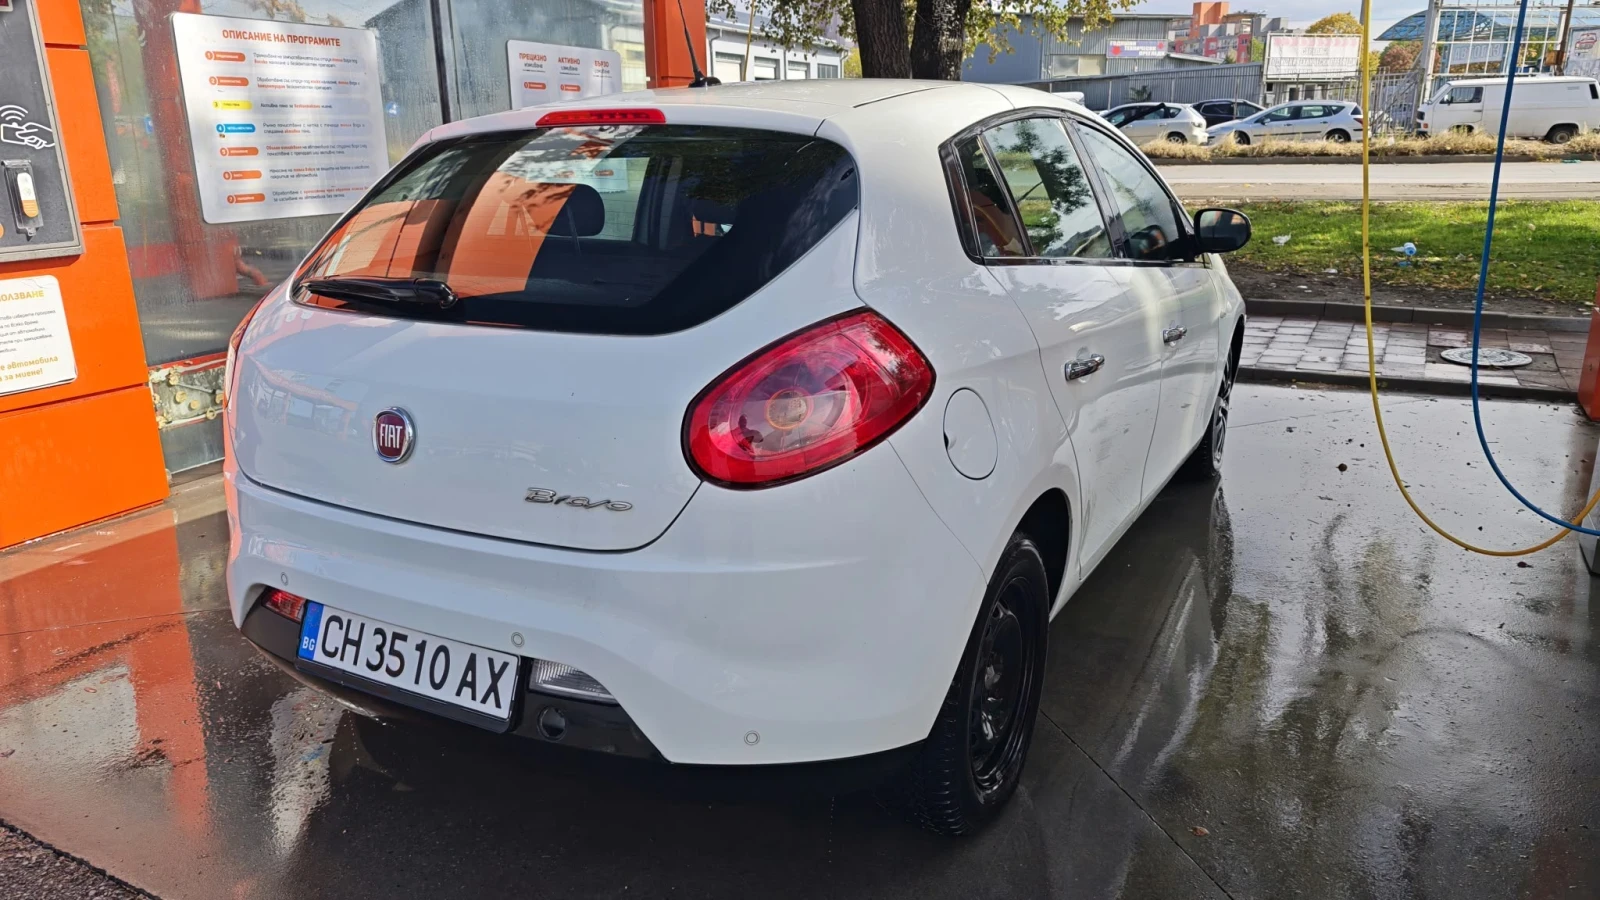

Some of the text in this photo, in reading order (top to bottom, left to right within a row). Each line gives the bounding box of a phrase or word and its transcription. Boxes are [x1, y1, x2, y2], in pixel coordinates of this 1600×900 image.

[222, 29, 341, 47] ОПИСАНИЕ НА ПРОГРАМИТЕ
[518, 53, 547, 62] ПРЕЦИЗНО
[558, 56, 580, 65] АКТИВНО
[0, 290, 44, 302] ОЛЗВАНЕ
[7, 356, 58, 370] автомобила
[15, 368, 44, 380] миене!
[380, 423, 403, 449] FIAT
[525, 487, 632, 511] Bravo
[302, 636, 316, 652] BG
[321, 614, 510, 710] CH 3510 AX
